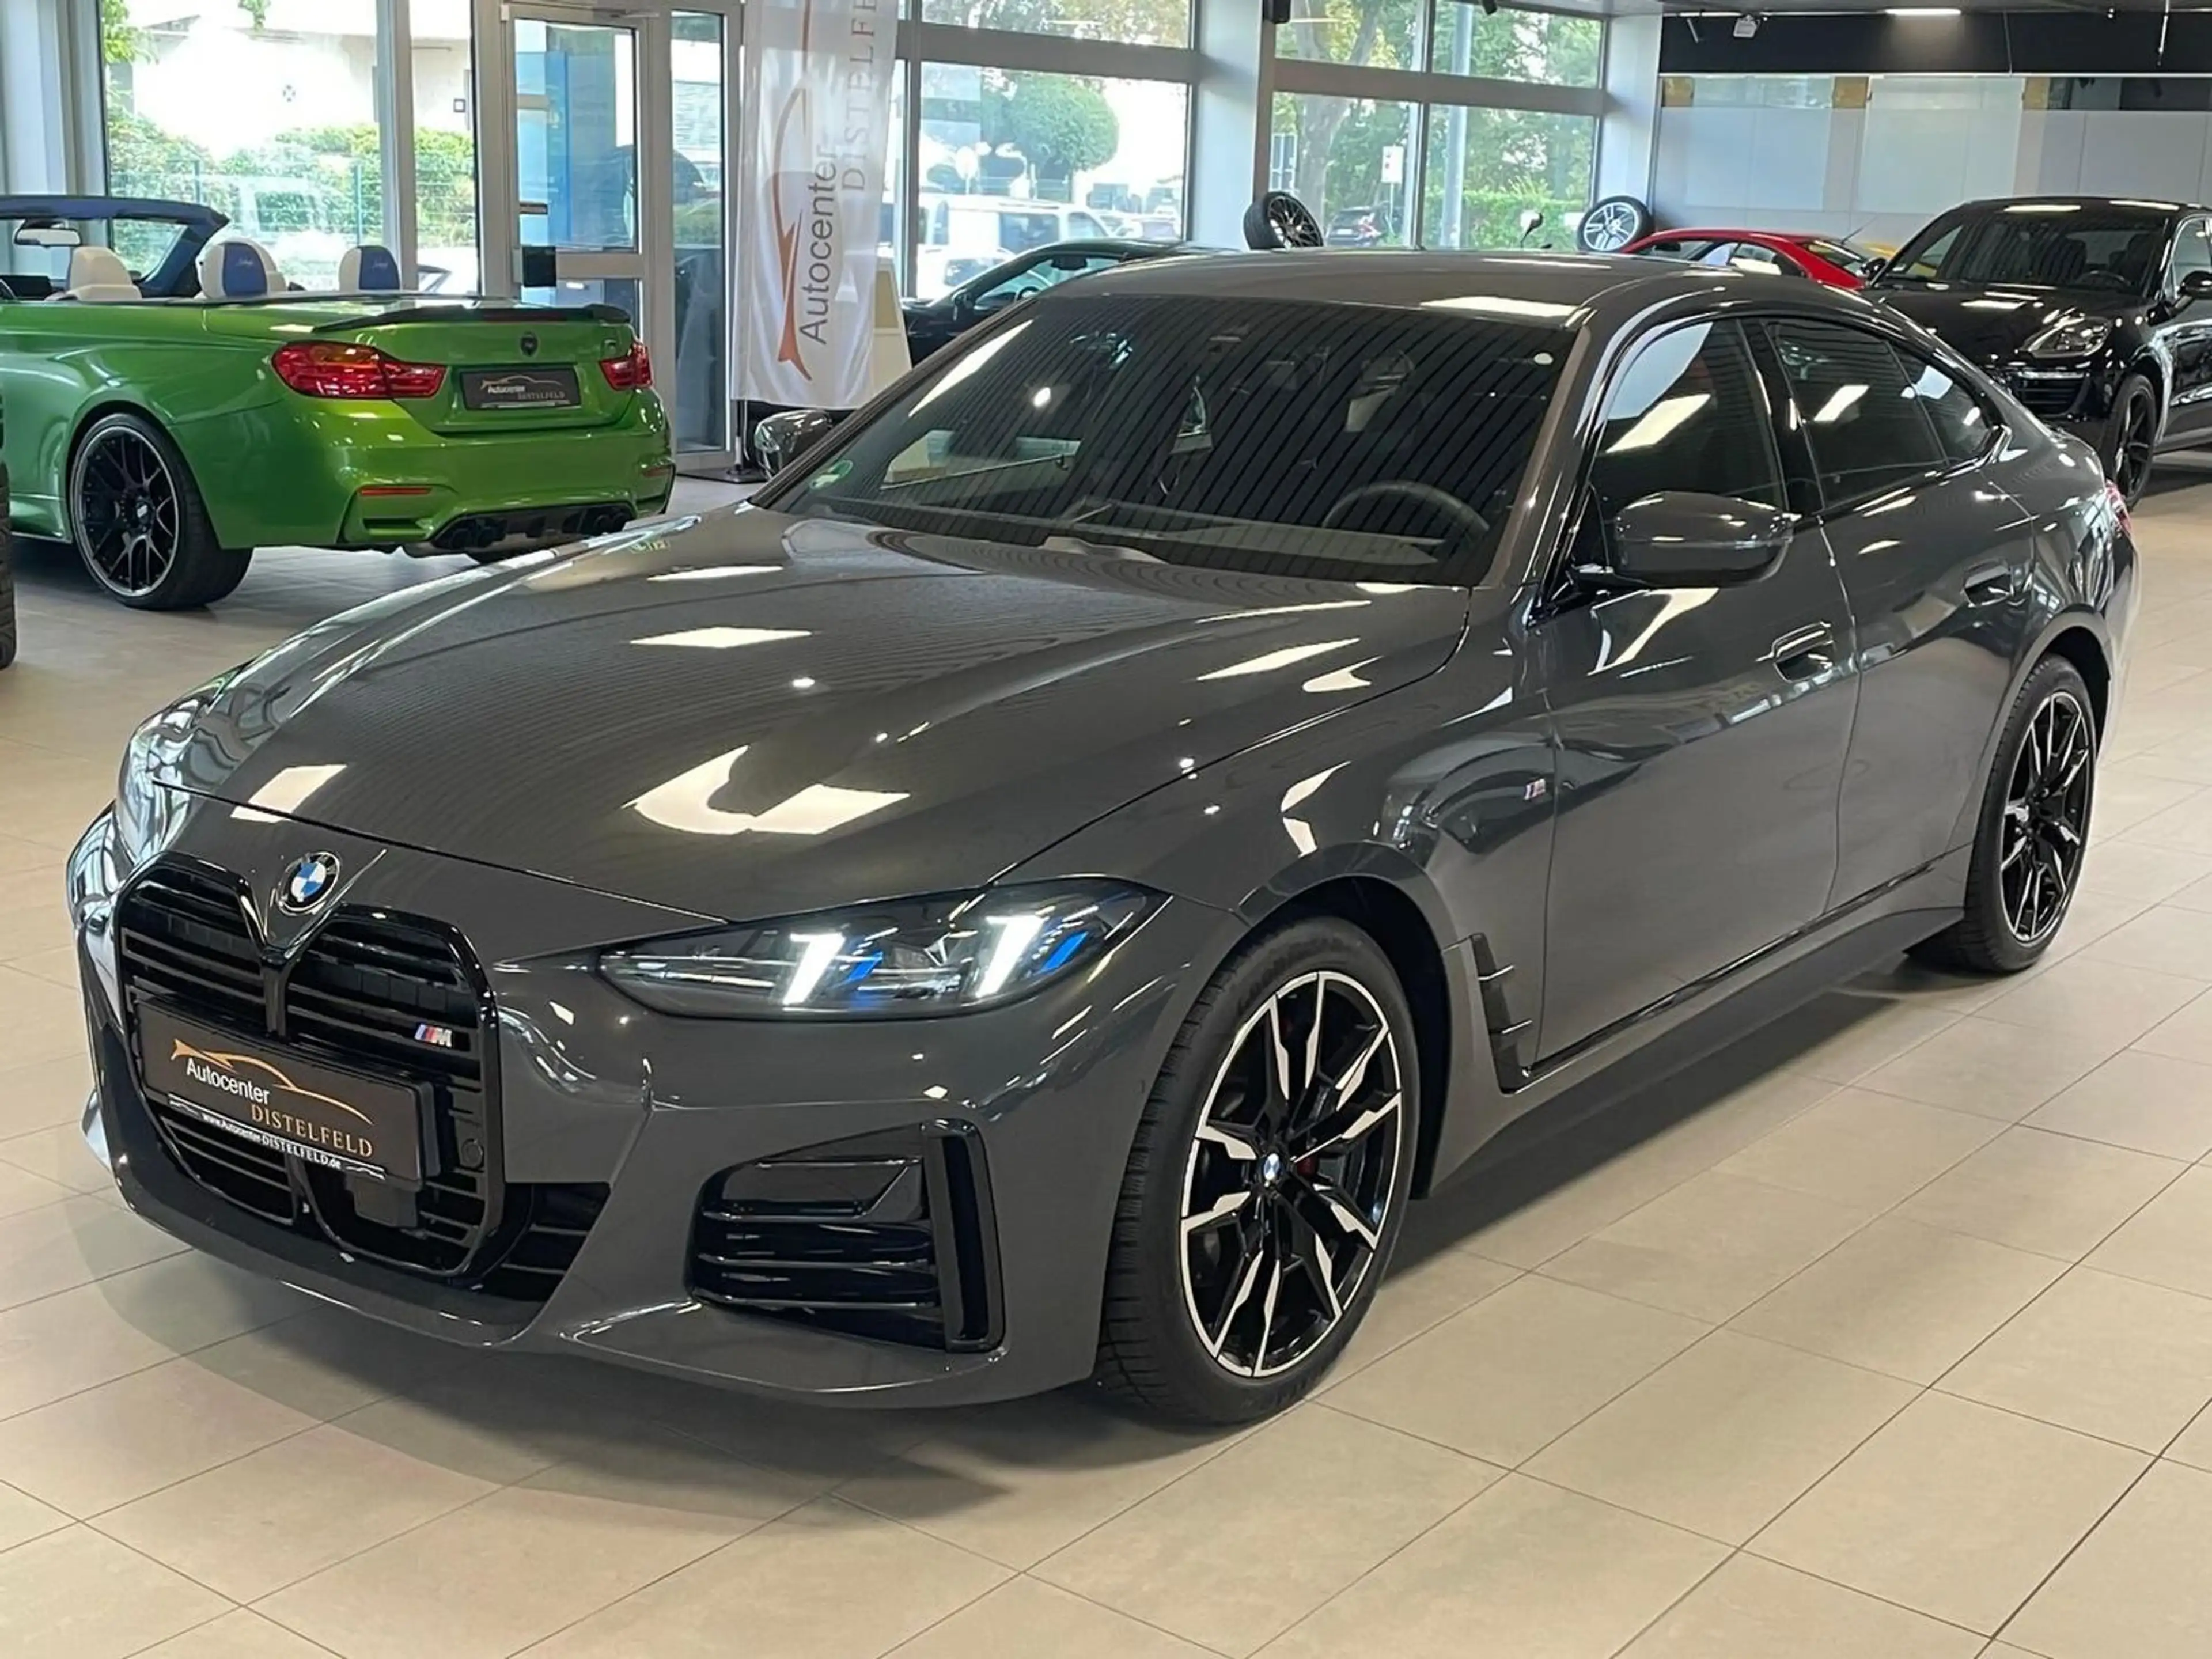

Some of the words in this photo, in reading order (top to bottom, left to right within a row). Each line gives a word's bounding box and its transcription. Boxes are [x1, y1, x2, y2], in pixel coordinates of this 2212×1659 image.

[798, 144, 836, 345] Autocenter
[187, 1057, 270, 1105] Autocenter
[251, 1104, 373, 1157] DISTELFELD
